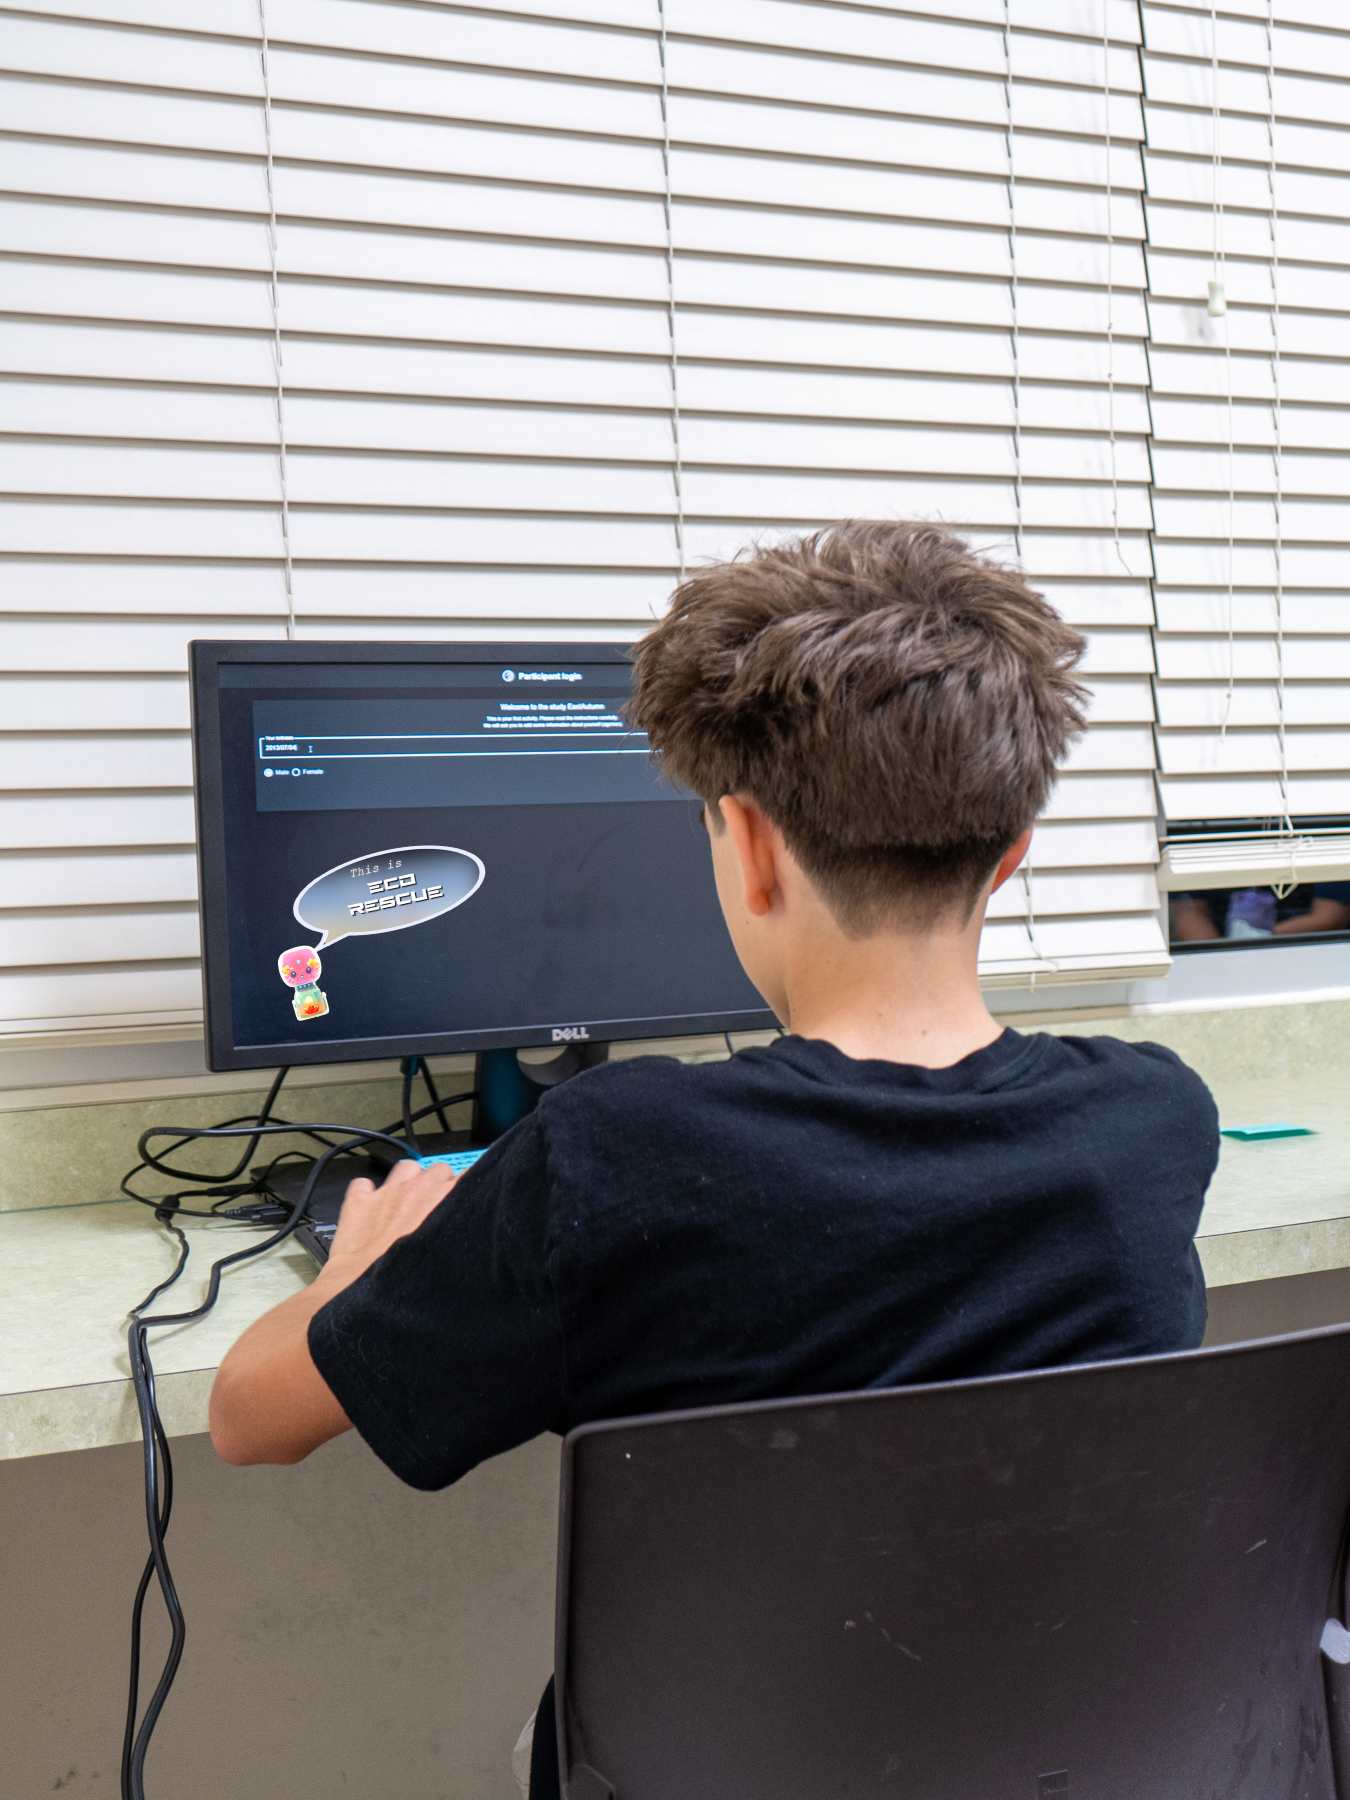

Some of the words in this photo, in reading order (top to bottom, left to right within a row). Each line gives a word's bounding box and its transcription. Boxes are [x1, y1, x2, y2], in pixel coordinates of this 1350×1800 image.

[518, 671, 561, 682] Participant
[562, 671, 583, 682] login
[499, 702, 530, 711] Welcome
[538, 702, 549, 710] the
[549, 702, 566, 711] study
[350, 864, 379, 878] This
[388, 859, 402, 870] is
[366, 873, 417, 894] ECO
[347, 885, 444, 916] RESCUE
[551, 1026, 590, 1042] DELL
